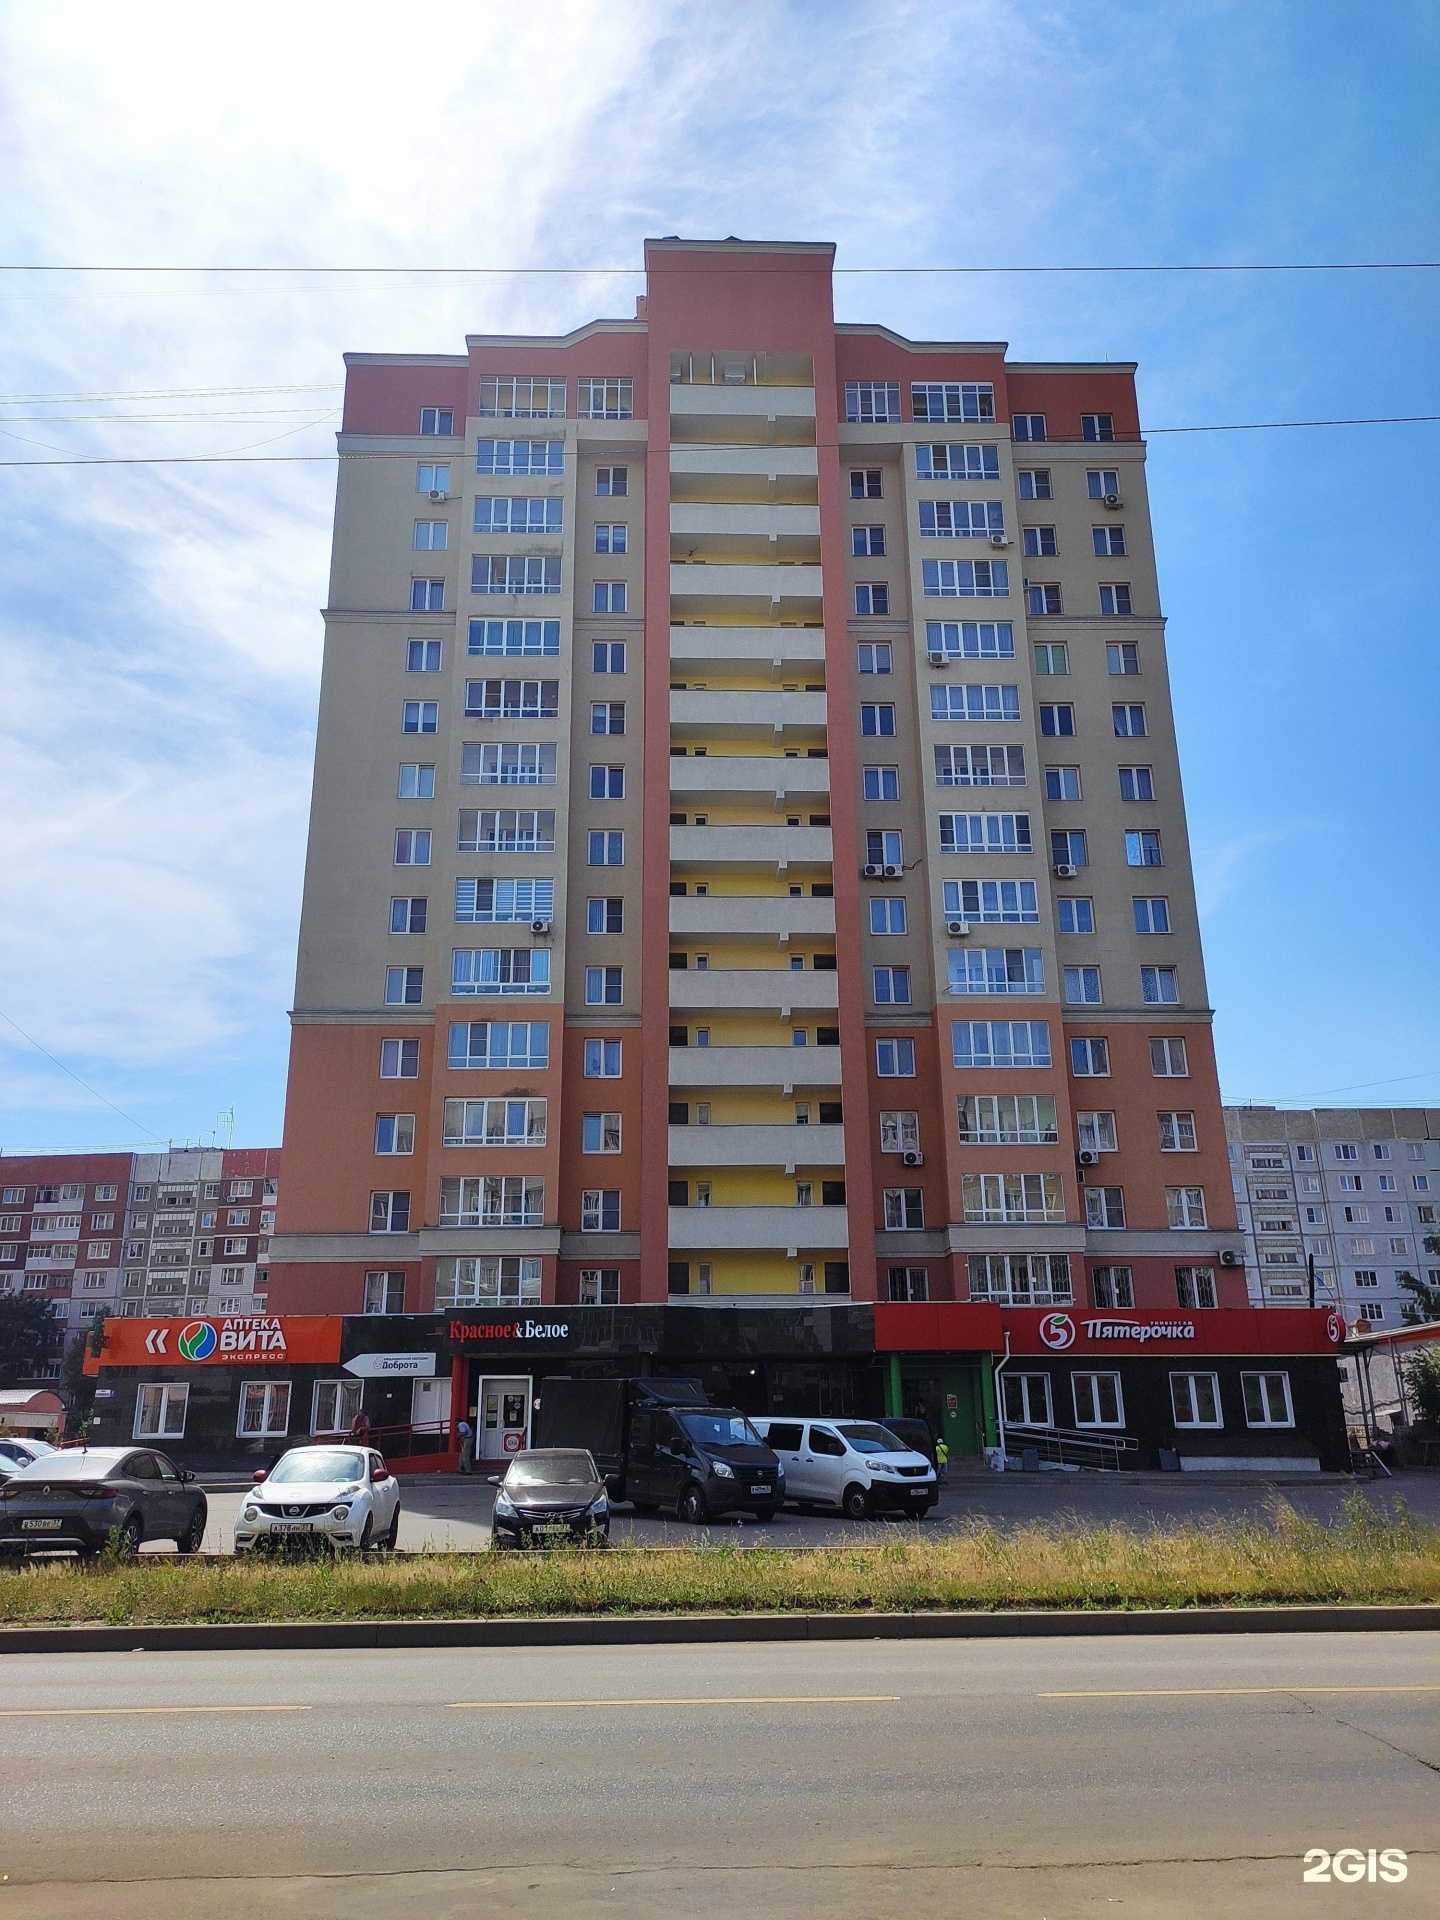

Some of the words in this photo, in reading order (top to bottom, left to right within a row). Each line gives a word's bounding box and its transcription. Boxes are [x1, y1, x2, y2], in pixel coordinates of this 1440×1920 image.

[222, 1319, 281, 1330] АПТЕКА
[219, 1330, 287, 1351] ВИТА
[221, 1353, 285, 1361] ЭКСПРЕСС
[382, 1361, 418, 1371] Доброта
